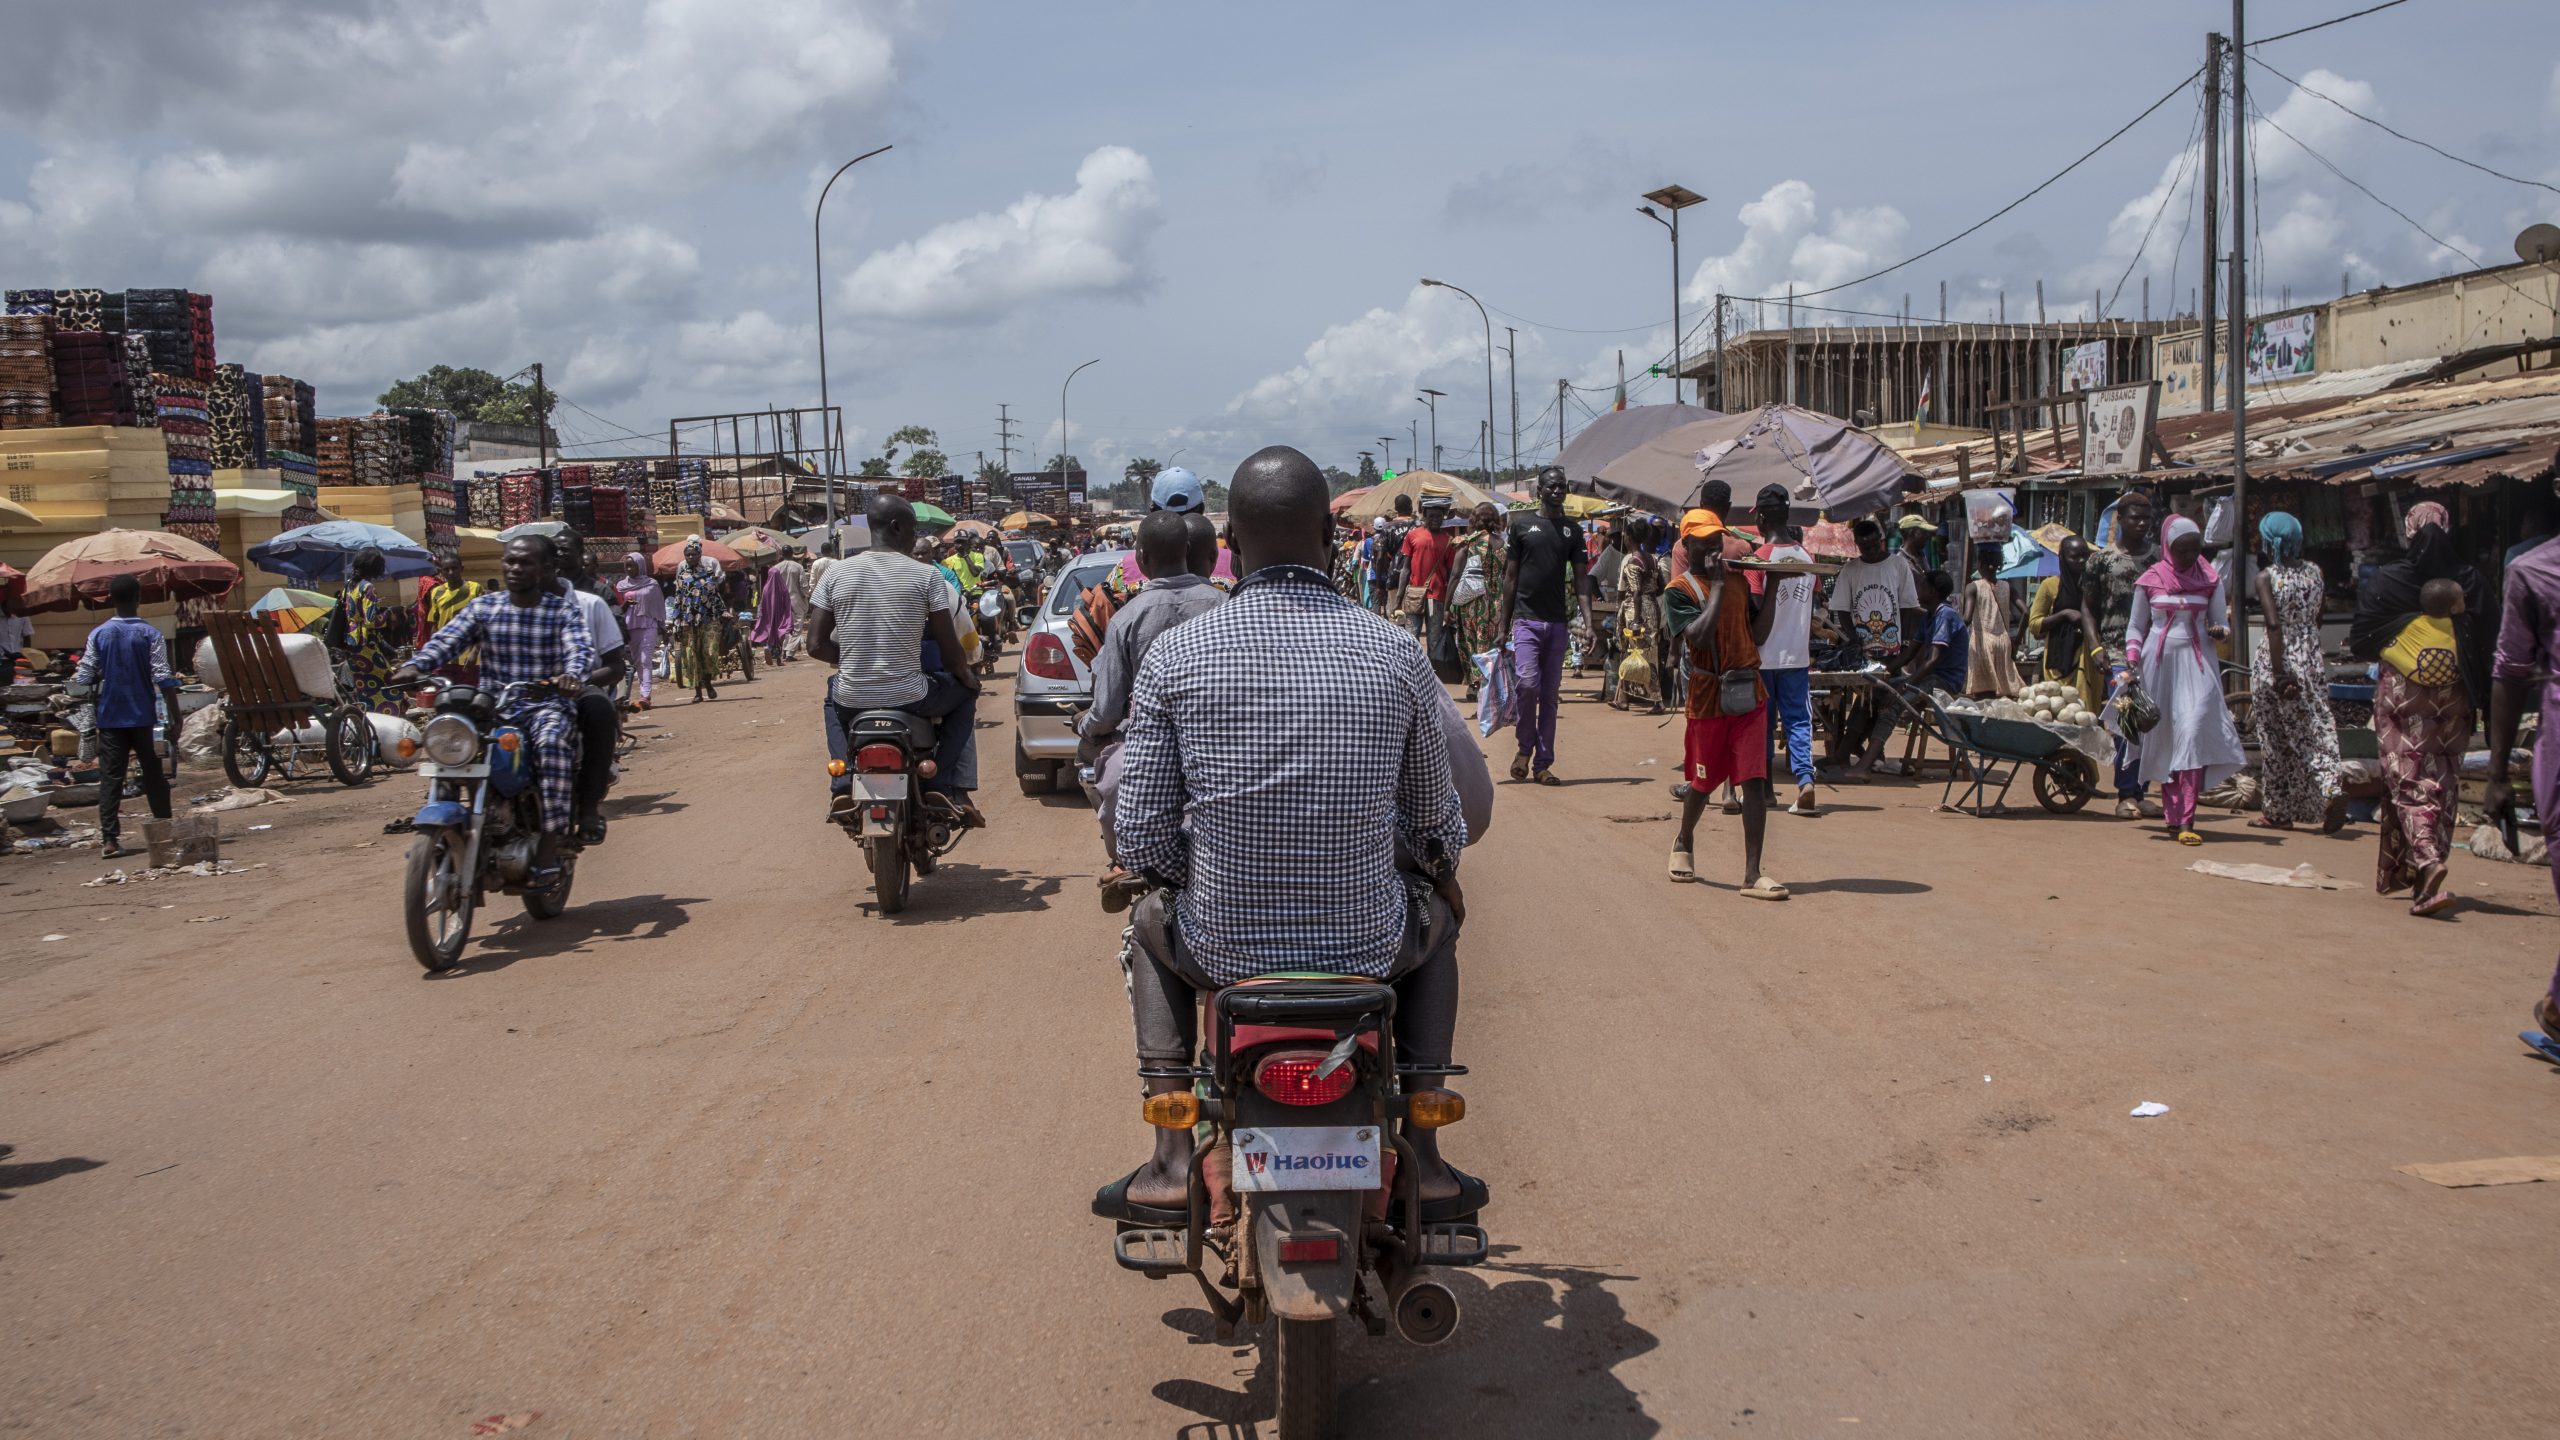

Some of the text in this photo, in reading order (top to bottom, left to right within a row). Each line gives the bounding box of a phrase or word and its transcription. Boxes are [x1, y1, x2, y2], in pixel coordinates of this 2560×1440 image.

[2100, 388, 2137, 403] PUISSANCE
[1863, 583, 1879, 592] AND
[1274, 1152, 1369, 1171] Haojue
